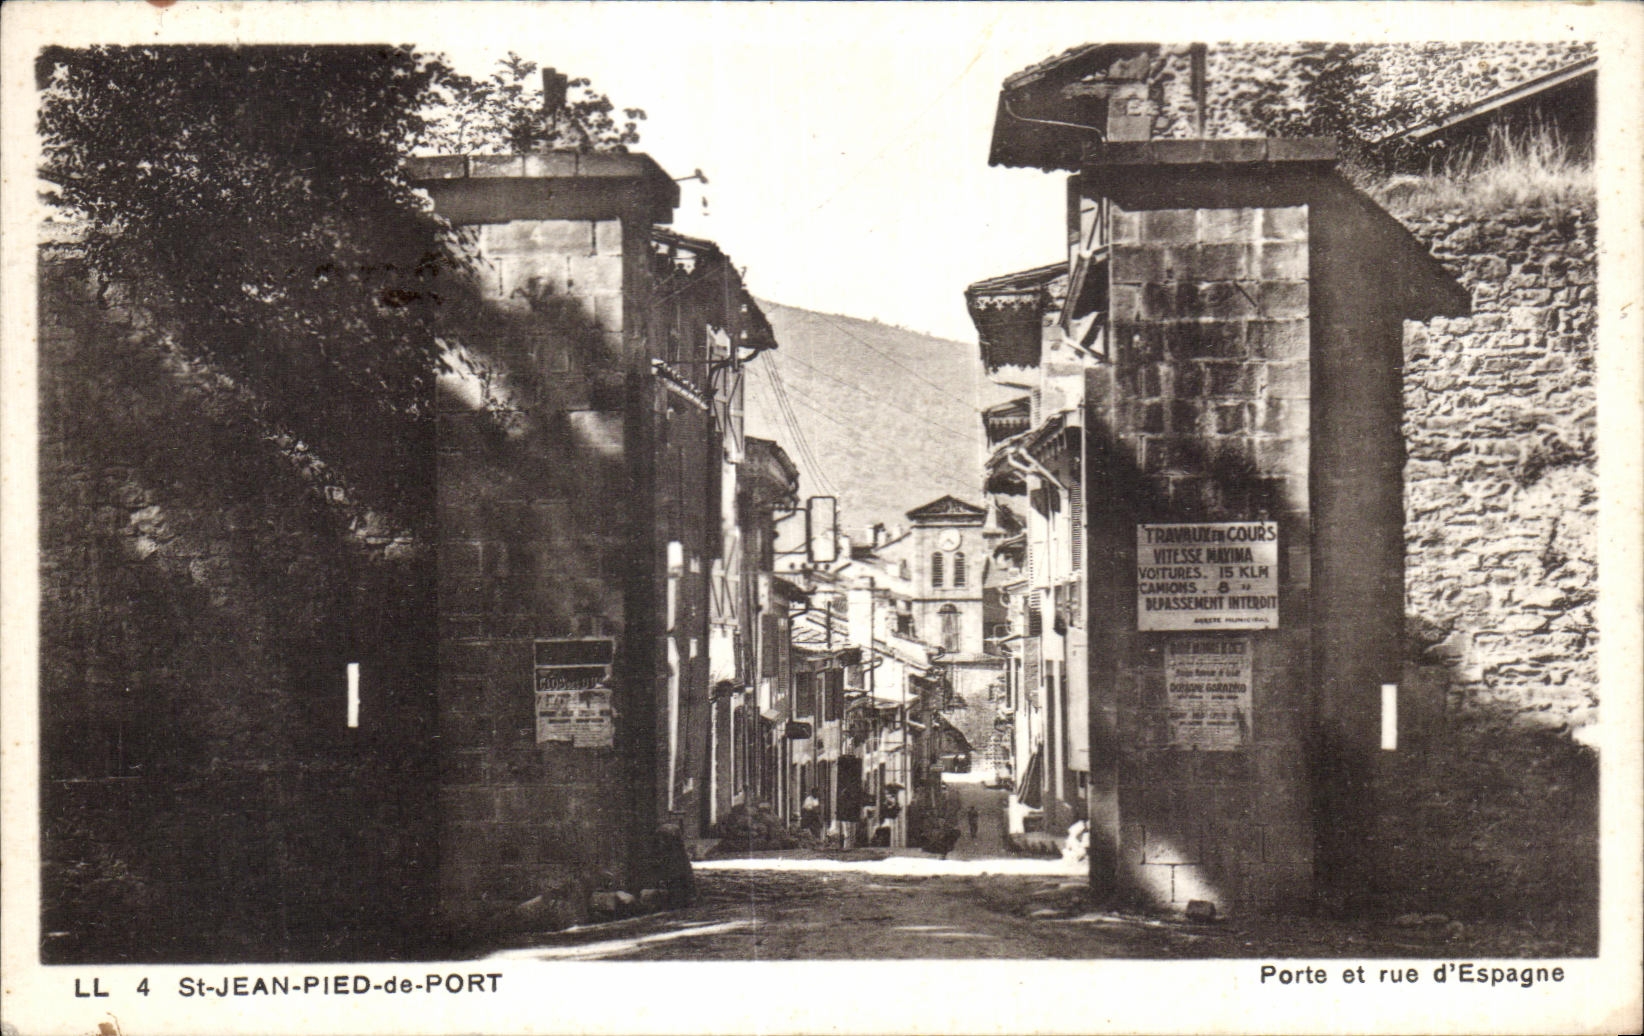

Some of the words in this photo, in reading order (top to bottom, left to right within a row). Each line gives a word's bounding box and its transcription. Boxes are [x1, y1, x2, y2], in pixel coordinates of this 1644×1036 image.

[1145, 526, 1211, 543] TRAVAUX
[1226, 526, 1277, 542] COURS
[1153, 548, 1203, 564] VITESSE
[1219, 565, 1234, 579] 15
[1239, 565, 1269, 579] KLM
[1217, 581, 1230, 593] 8
[1228, 595, 1277, 610] INTERDIT
